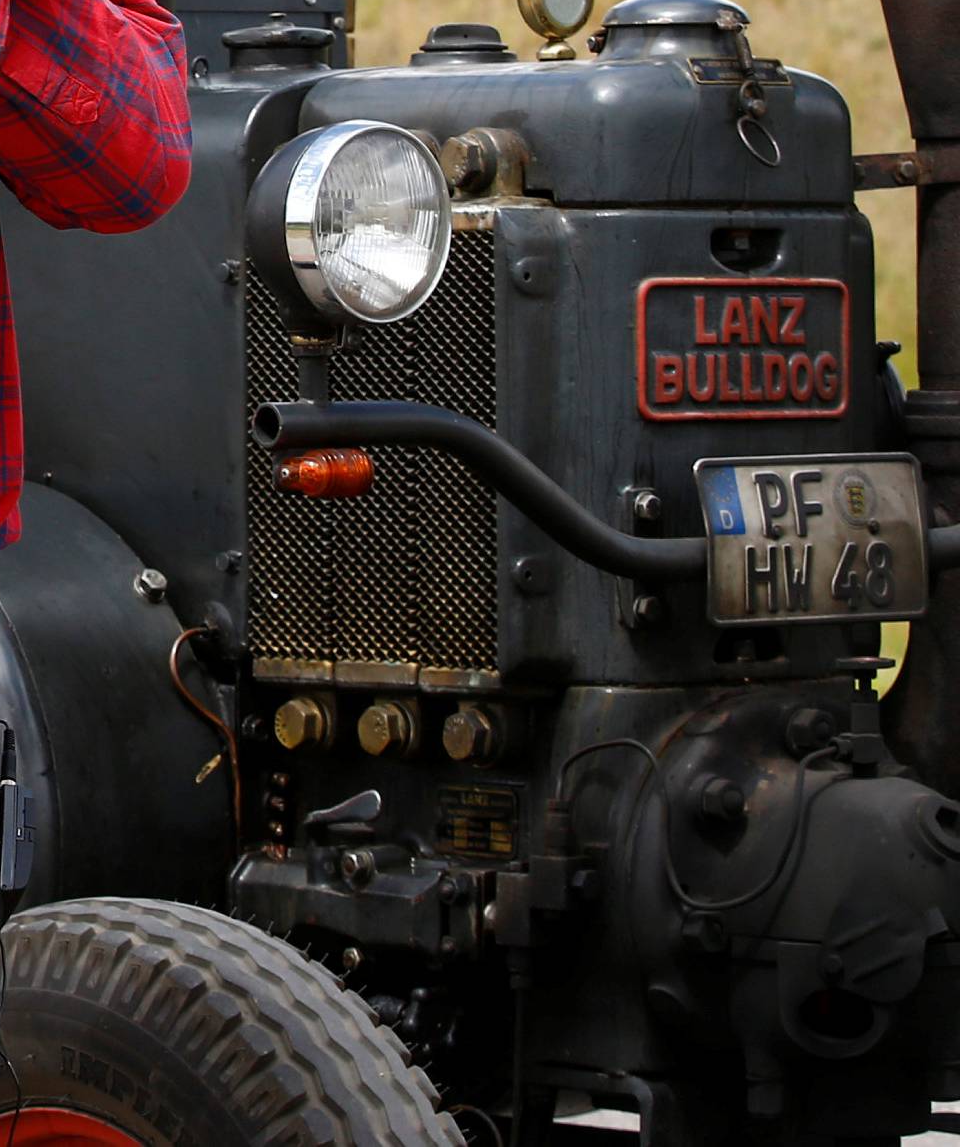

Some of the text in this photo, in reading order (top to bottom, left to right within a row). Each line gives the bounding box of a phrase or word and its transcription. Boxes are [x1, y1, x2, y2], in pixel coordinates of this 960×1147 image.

[694, 294, 806, 345] LANZ
[653, 351, 838, 403] BULLDOG
[719, 509, 734, 530] D
[751, 470, 824, 538] PF
[744, 540, 896, 613] HW 48
